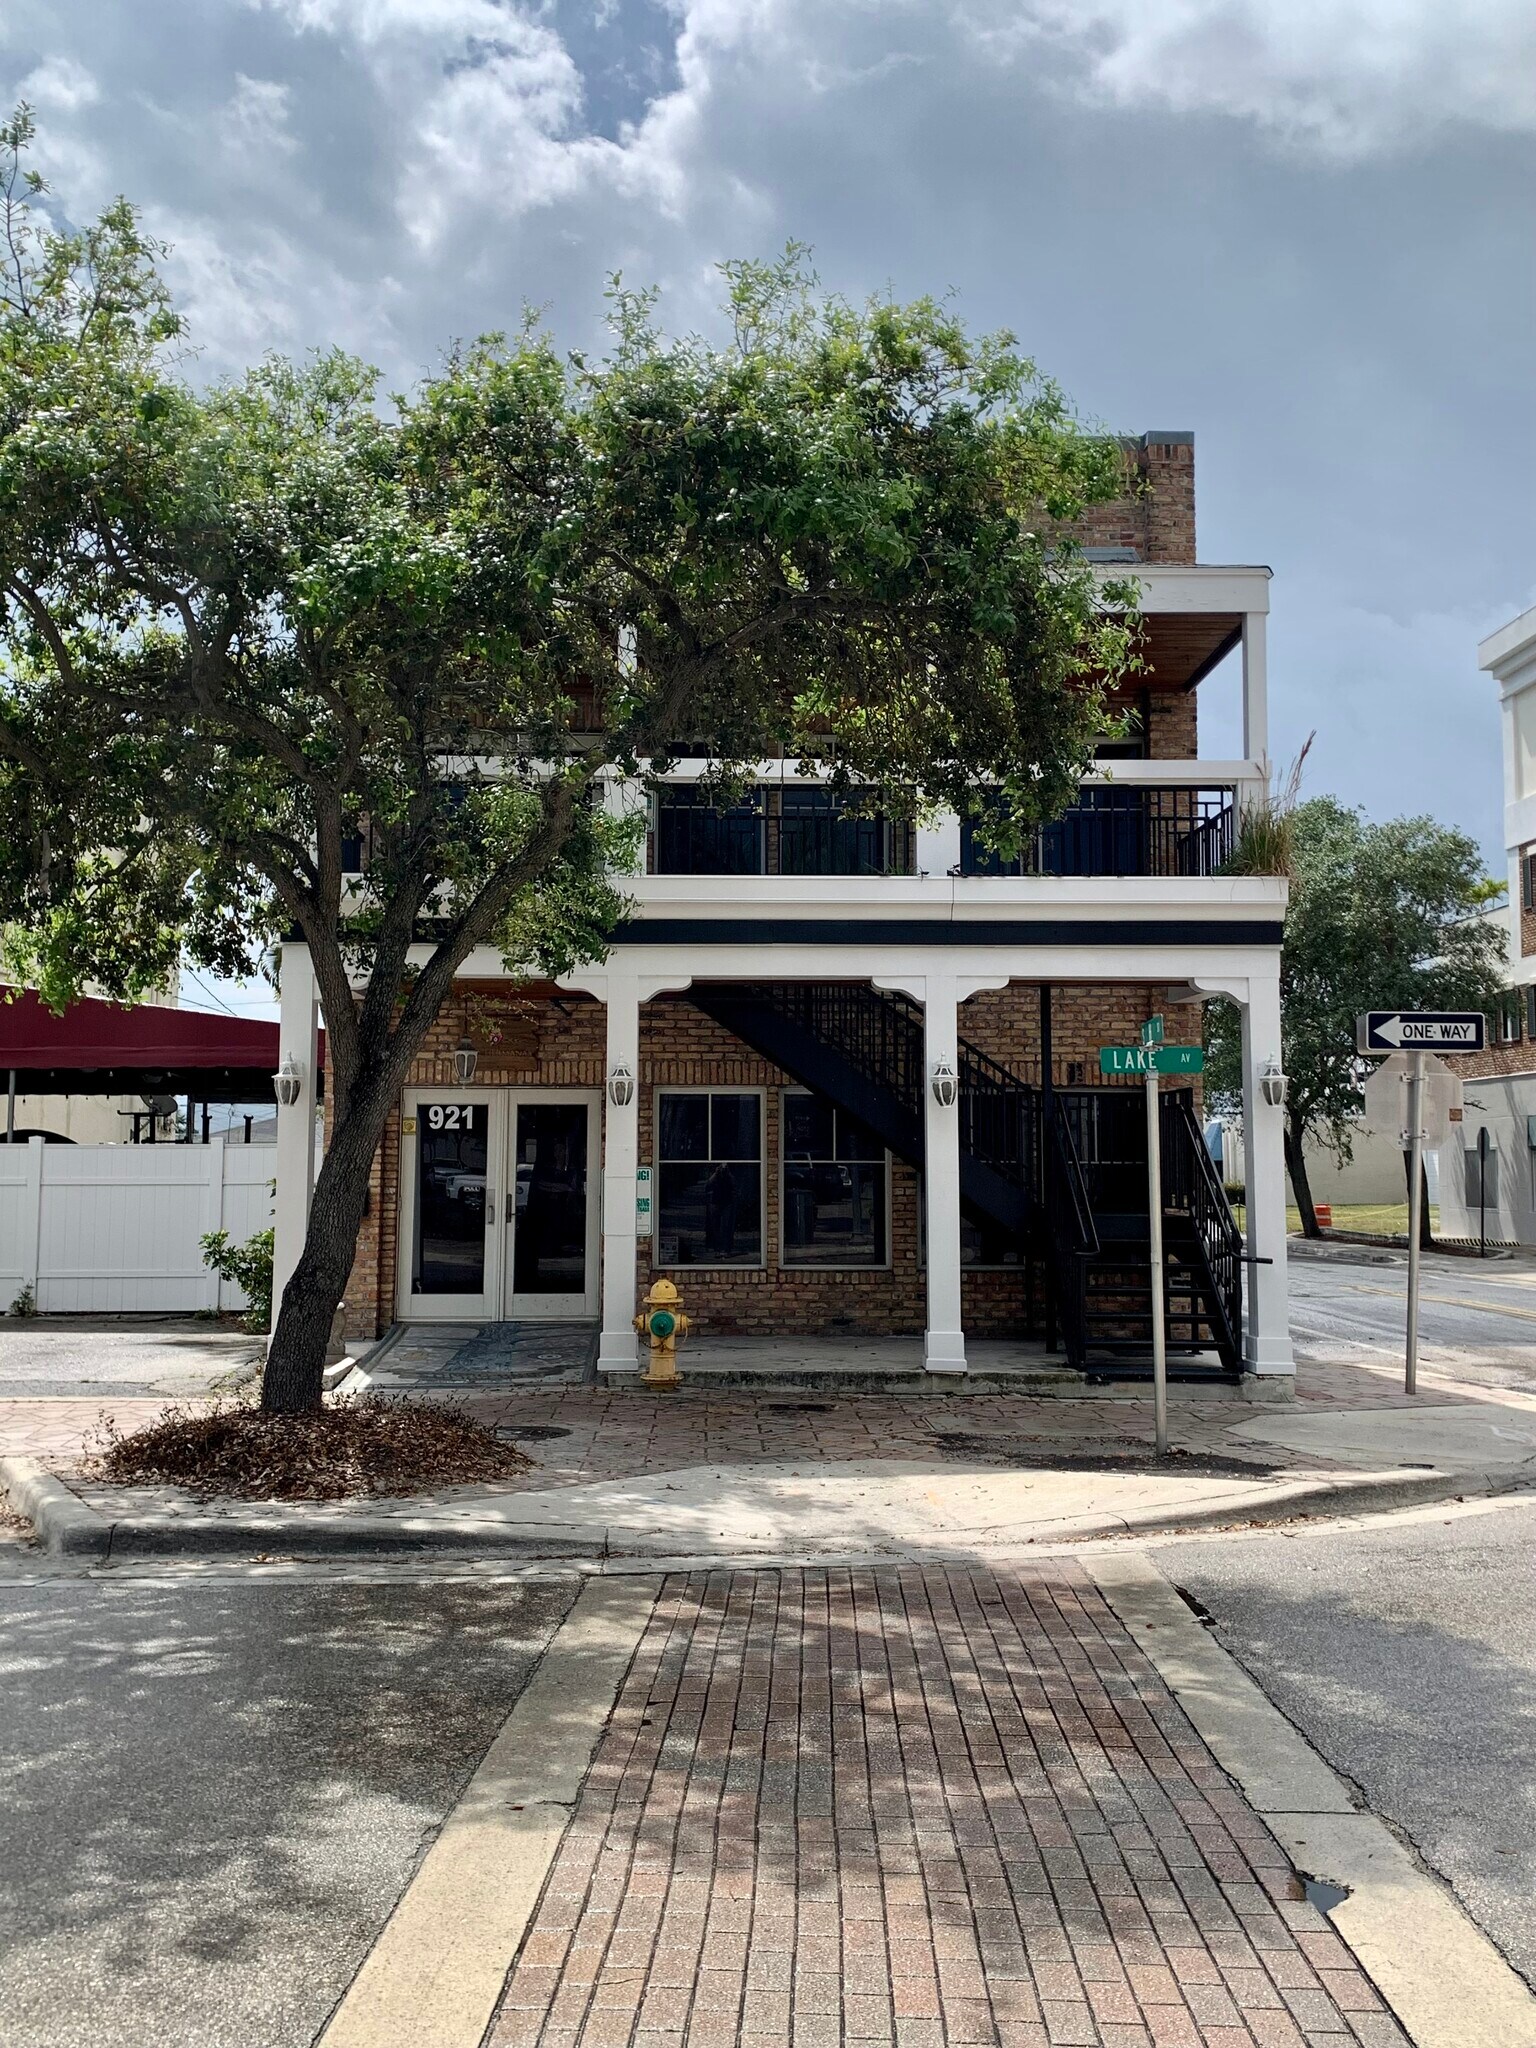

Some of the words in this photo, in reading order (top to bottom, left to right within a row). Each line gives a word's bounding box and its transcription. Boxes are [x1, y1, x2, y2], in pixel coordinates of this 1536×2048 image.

[1402, 1024, 1434, 1039] ONE
[1439, 1024, 1471, 1039] WAY
[1113, 1050, 1157, 1069] LAKE
[1180, 1053, 1191, 1063] AV
[428, 1105, 473, 1130] 921
